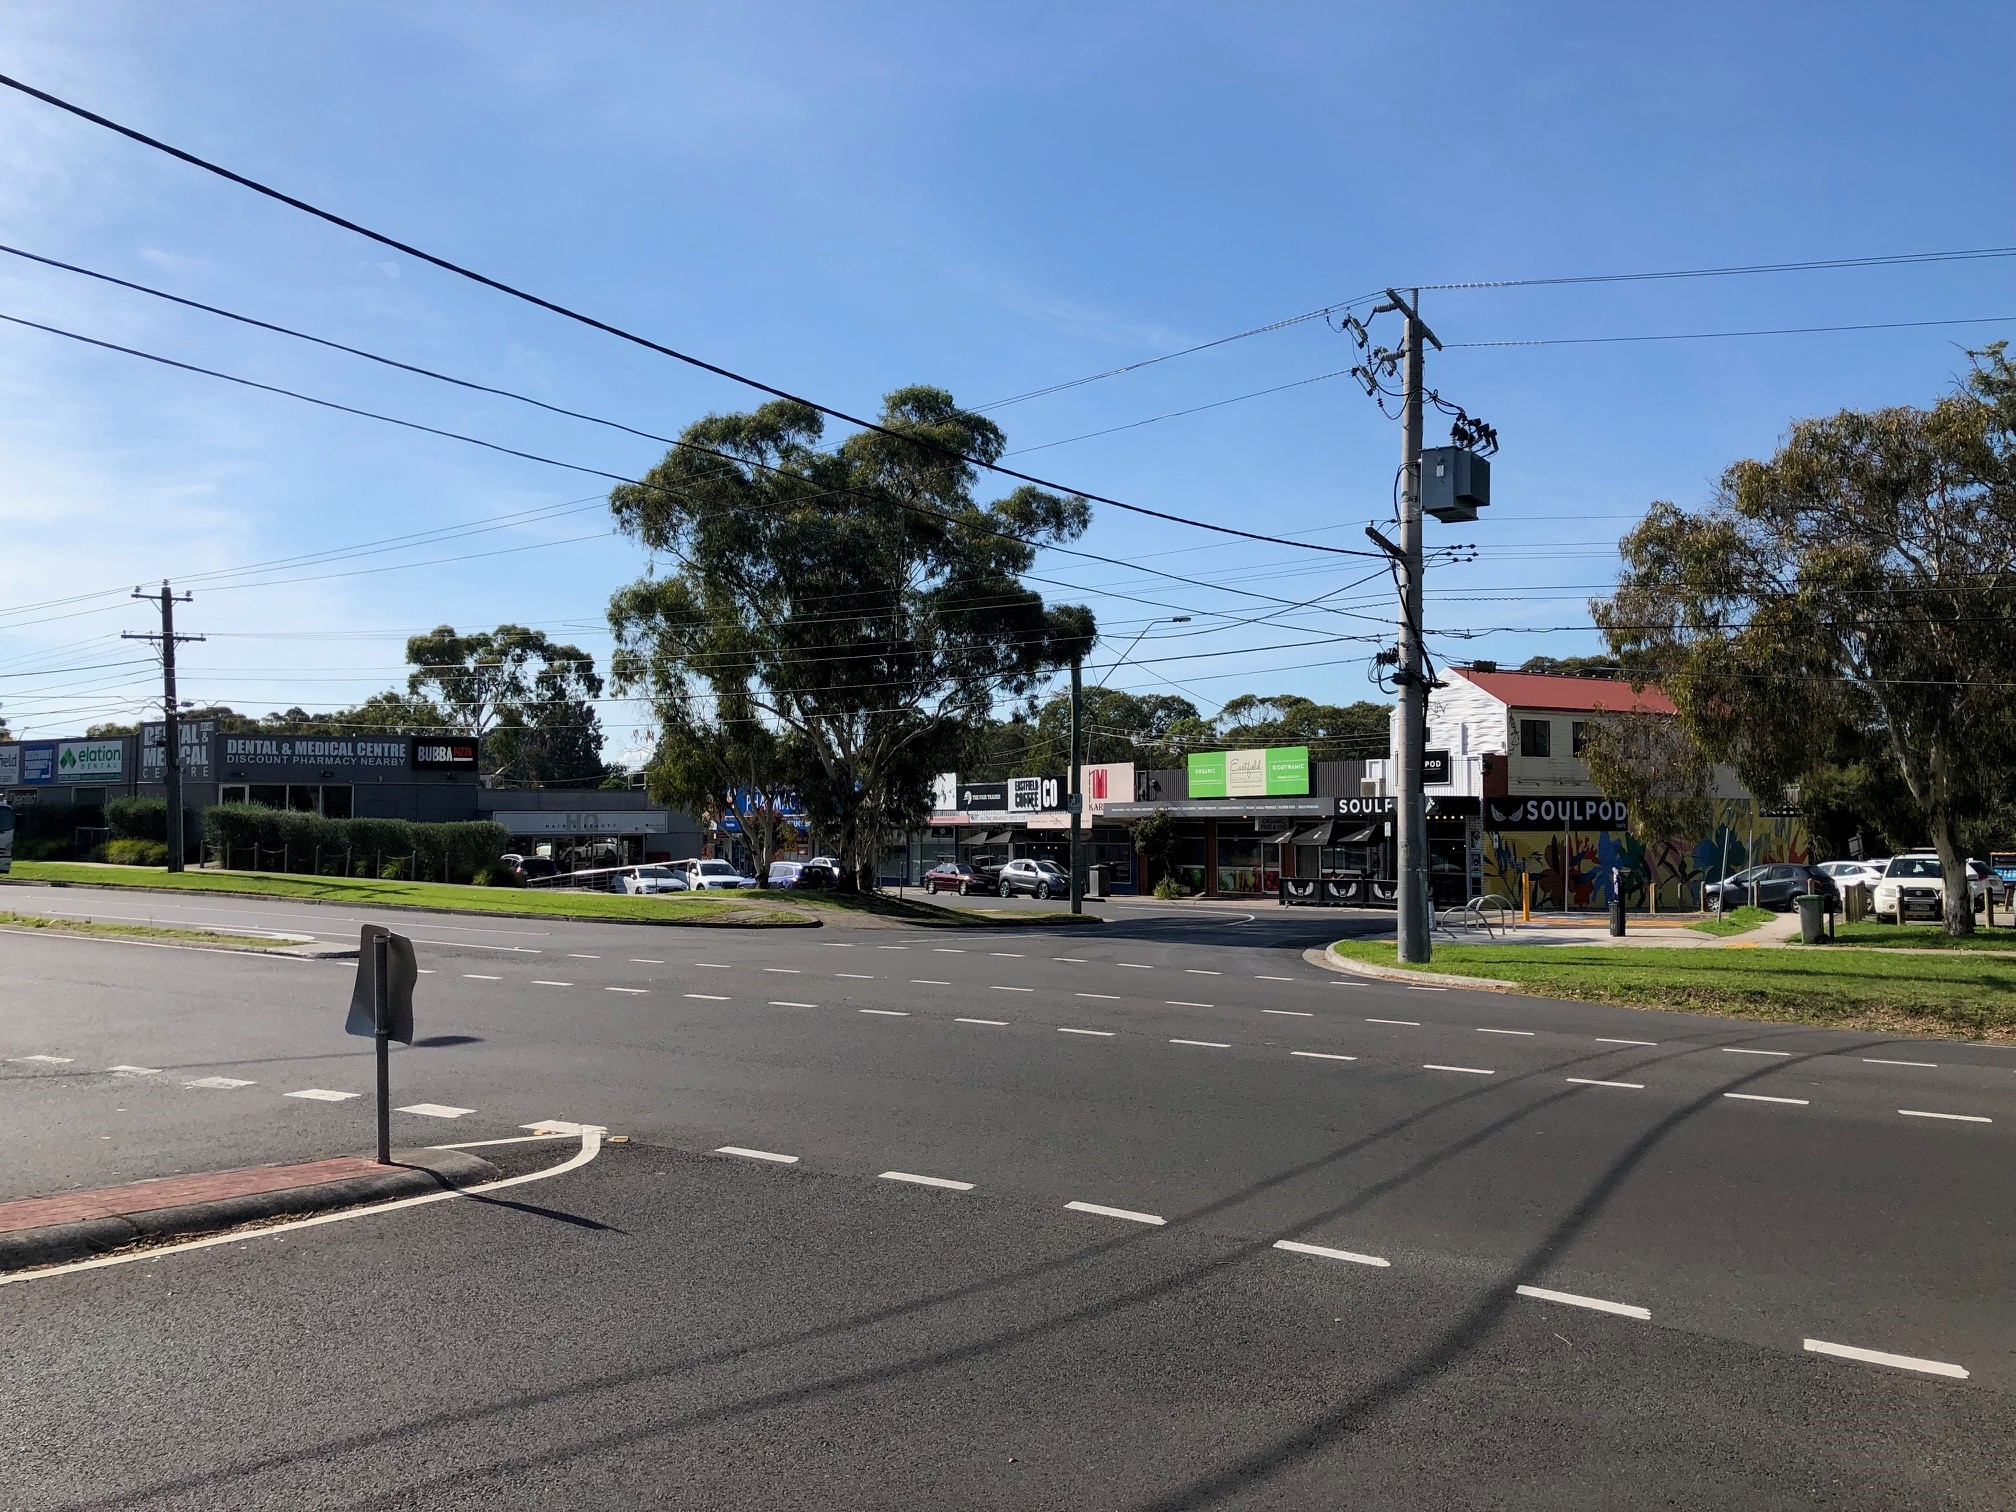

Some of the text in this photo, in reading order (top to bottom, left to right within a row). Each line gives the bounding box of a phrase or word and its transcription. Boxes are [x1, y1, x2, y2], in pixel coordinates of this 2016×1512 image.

[144, 725, 199, 746] DEAL
[202, 731, 209, 743] &
[78, 745, 121, 762] elation
[142, 745, 209, 767] MECAL
[227, 739, 406, 757] DENTAL & MEDICAL CENTRE
[417, 745, 473, 762] BUBBA PIZZA
[226, 755, 406, 766] DISCOUNT PHARMACY NEARBY
[1230, 758, 1262, 778] Eastfield
[1272, 763, 1304, 771] BIODYNAMIC
[1195, 767, 1216, 775] ORGANIC
[1015, 779, 1039, 791] EASTFIELD
[1042, 778, 1058, 808] CO
[1015, 792, 1039, 808] COFFEE
[1089, 803, 1104, 812] KAR
[1526, 800, 1627, 821] SOULPOD
